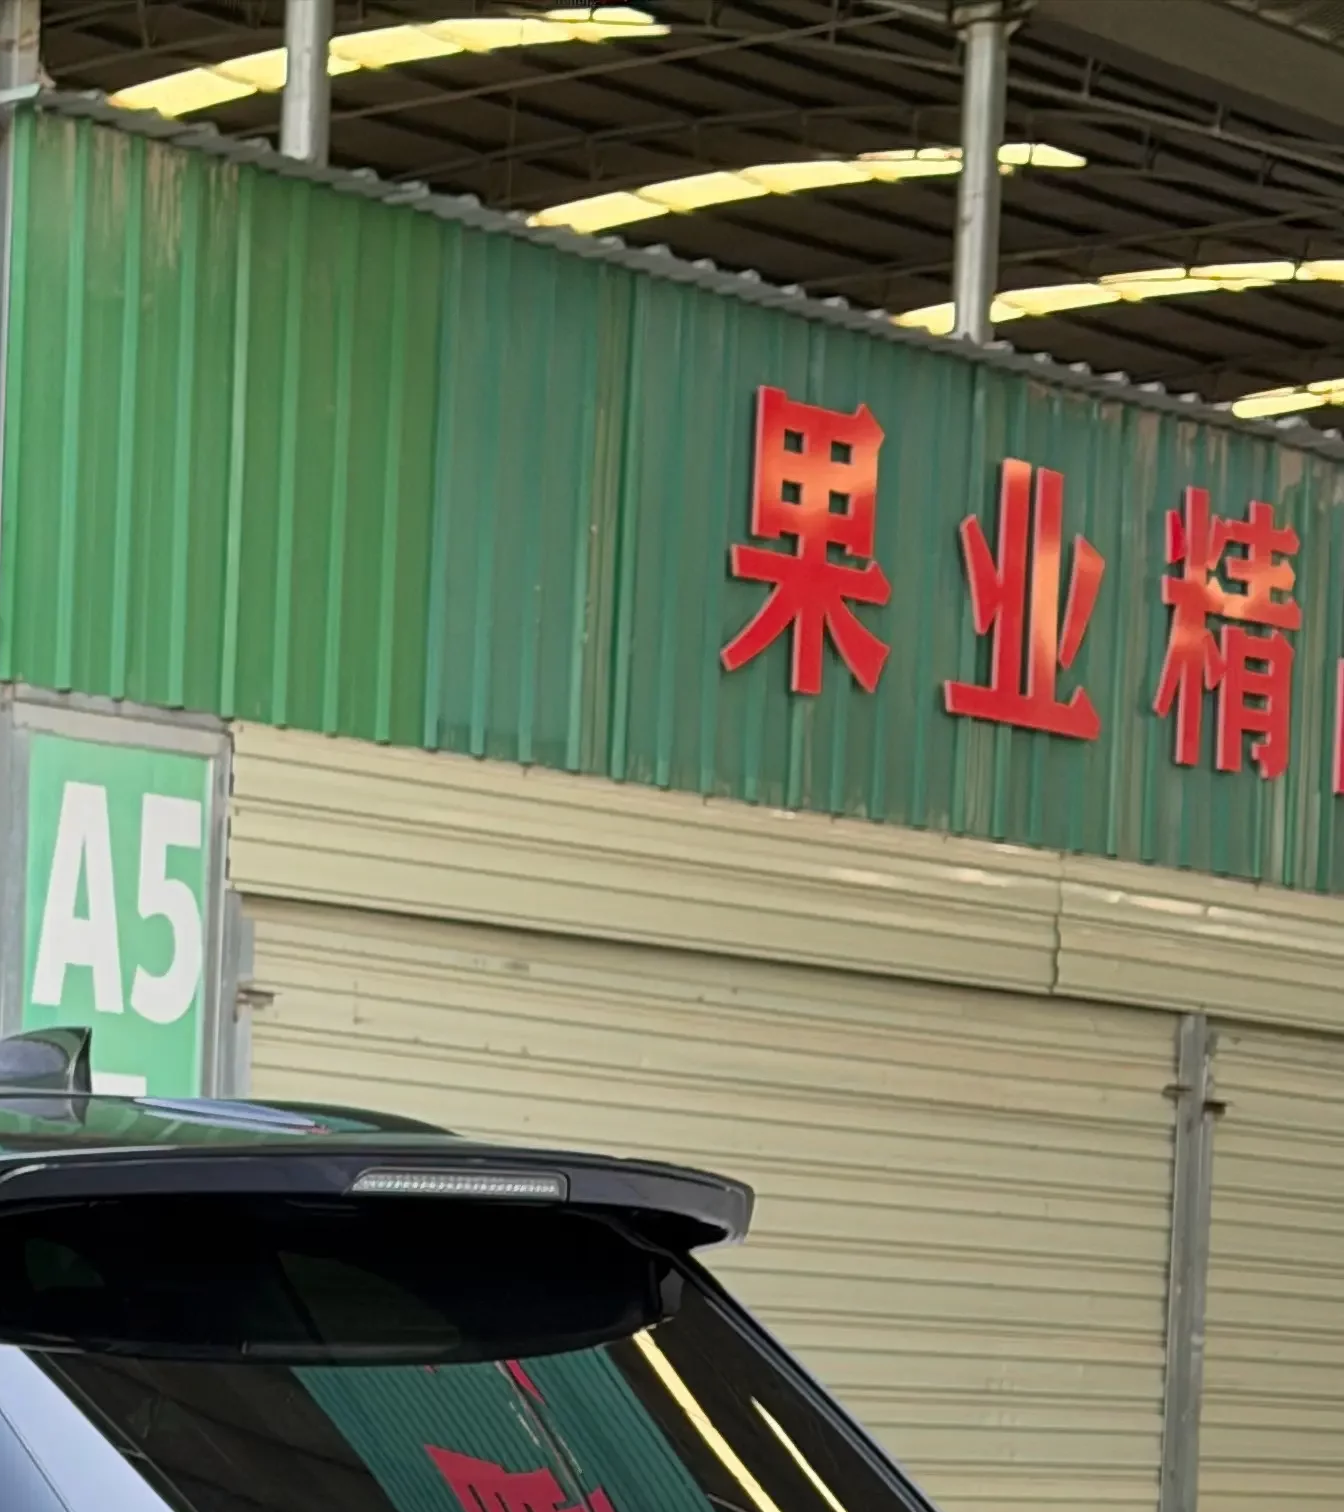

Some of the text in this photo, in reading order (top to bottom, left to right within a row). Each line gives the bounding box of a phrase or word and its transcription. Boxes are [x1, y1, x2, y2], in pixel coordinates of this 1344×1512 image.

[722, 386, 1344, 795] 果业精
[31, 781, 204, 1024] A5
